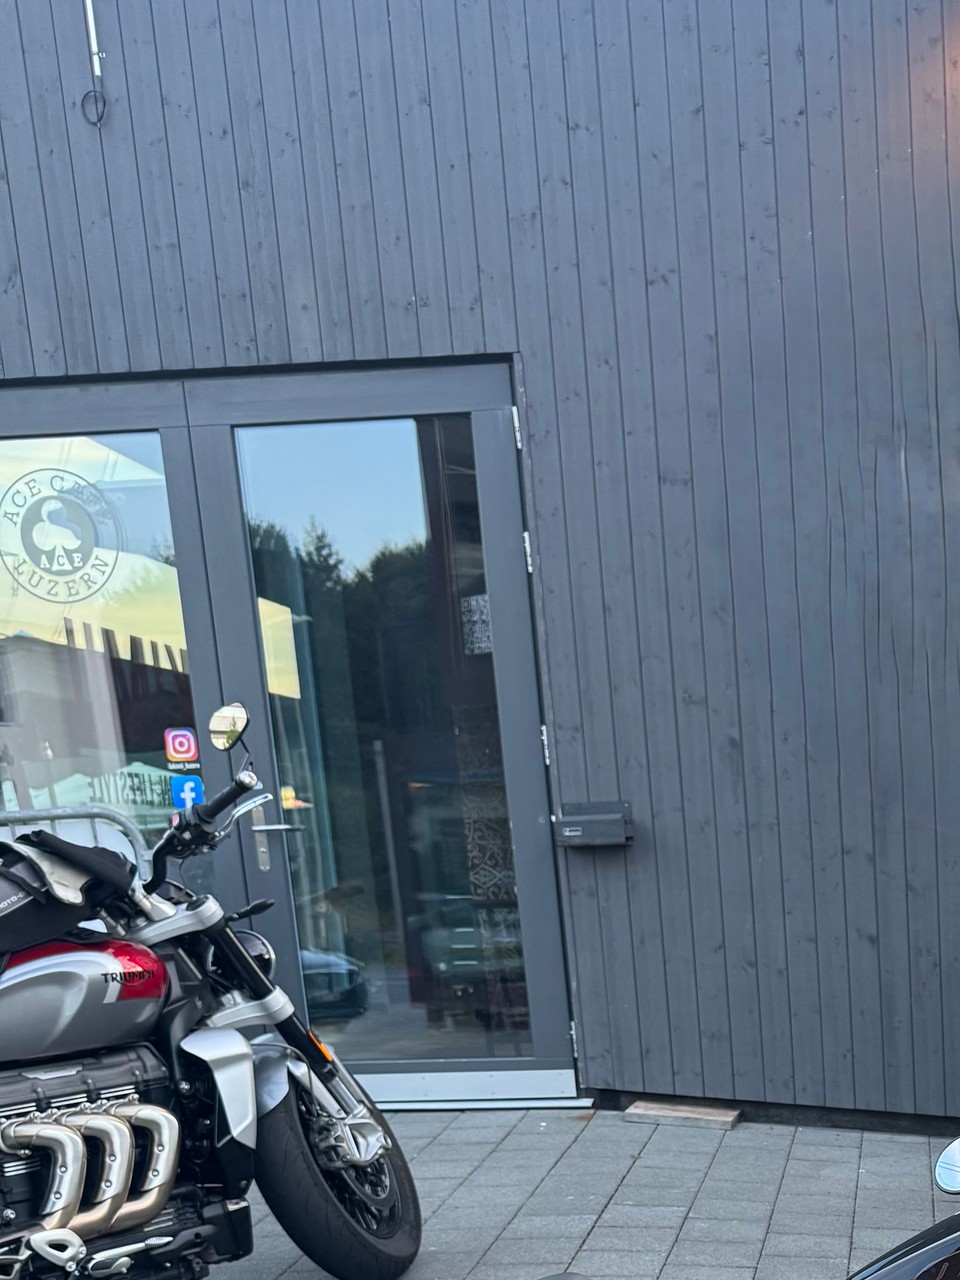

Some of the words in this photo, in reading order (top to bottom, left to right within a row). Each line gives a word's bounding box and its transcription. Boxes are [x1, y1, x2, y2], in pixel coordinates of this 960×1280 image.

[3, 478, 42, 527] ACE
[39, 552, 84, 571] ACE
[13, 556, 111, 599] LUZERN
[101, 970, 155, 986] TRIUMPH
